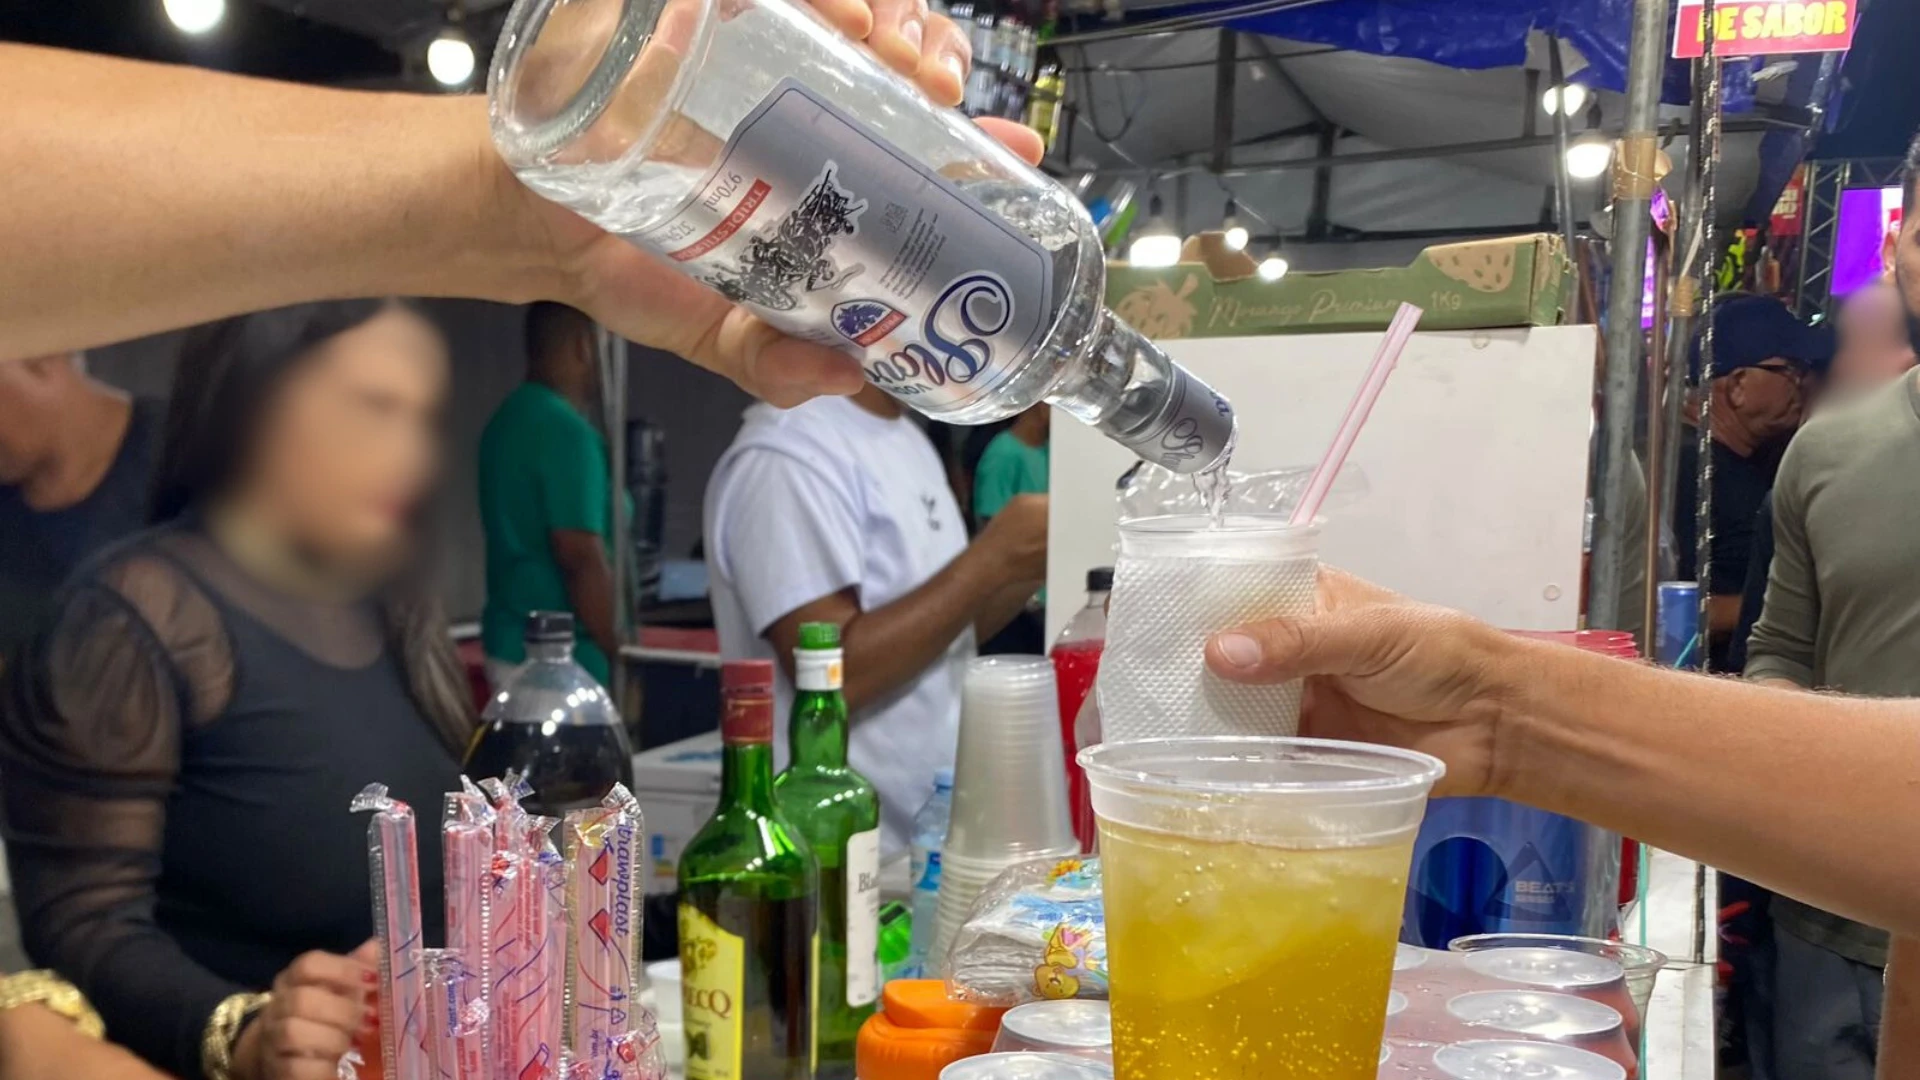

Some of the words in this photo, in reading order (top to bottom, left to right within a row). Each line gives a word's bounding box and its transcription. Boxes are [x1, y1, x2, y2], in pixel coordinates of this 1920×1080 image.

[1741, 1, 1848, 38] SABOR
[703, 172, 742, 213] 970ml
[1431, 290, 1461, 310] 1Kg
[864, 274, 1011, 387] Slov
